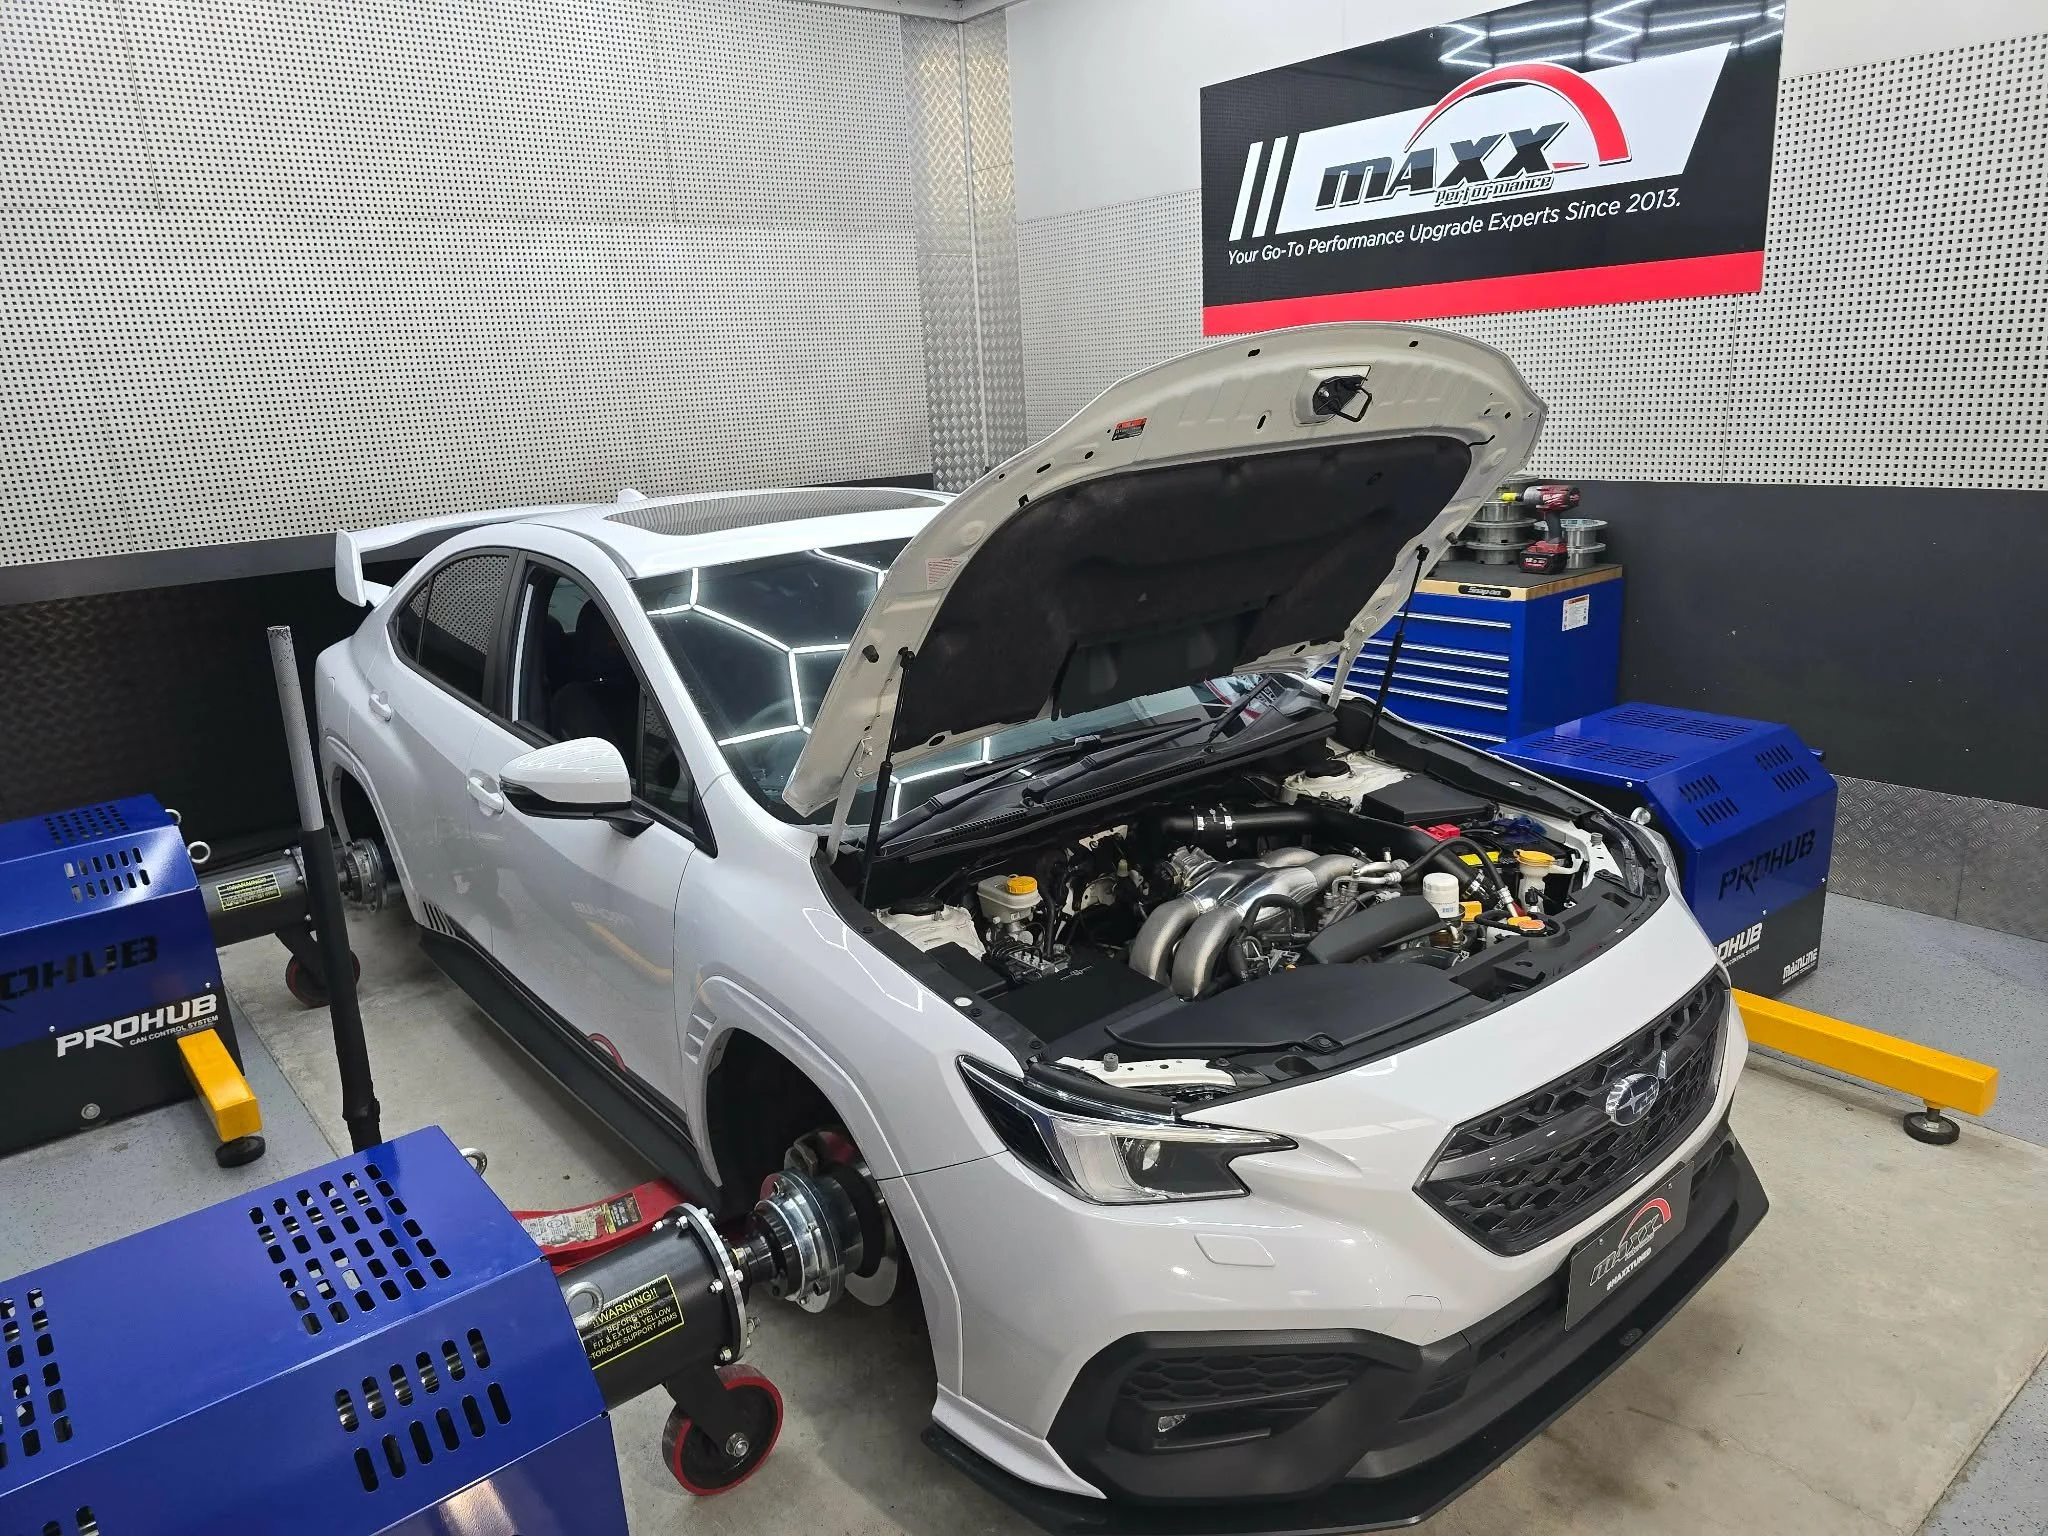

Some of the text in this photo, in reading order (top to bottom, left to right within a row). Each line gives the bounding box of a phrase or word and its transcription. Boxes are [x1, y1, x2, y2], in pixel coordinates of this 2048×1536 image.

[1228, 187, 1681, 265] Your Go-To Performance Upgrade Experts Since 2013.
[1718, 829, 1816, 901] PROHUB
[1714, 922, 1763, 961] OHUB
[0, 935, 158, 1013] OHUB
[56, 993, 217, 1058] PROHUB
[130, 1014, 219, 1047] CAN CONTROL SYSTEM
[591, 1311, 678, 1360] TORQUE SUPPORT ARMS
[593, 1338, 604, 1350] FIT
[612, 1321, 642, 1340] EXTEND
[641, 1306, 672, 1327] YELLOW
[606, 1306, 653, 1334] BEFORE USE
